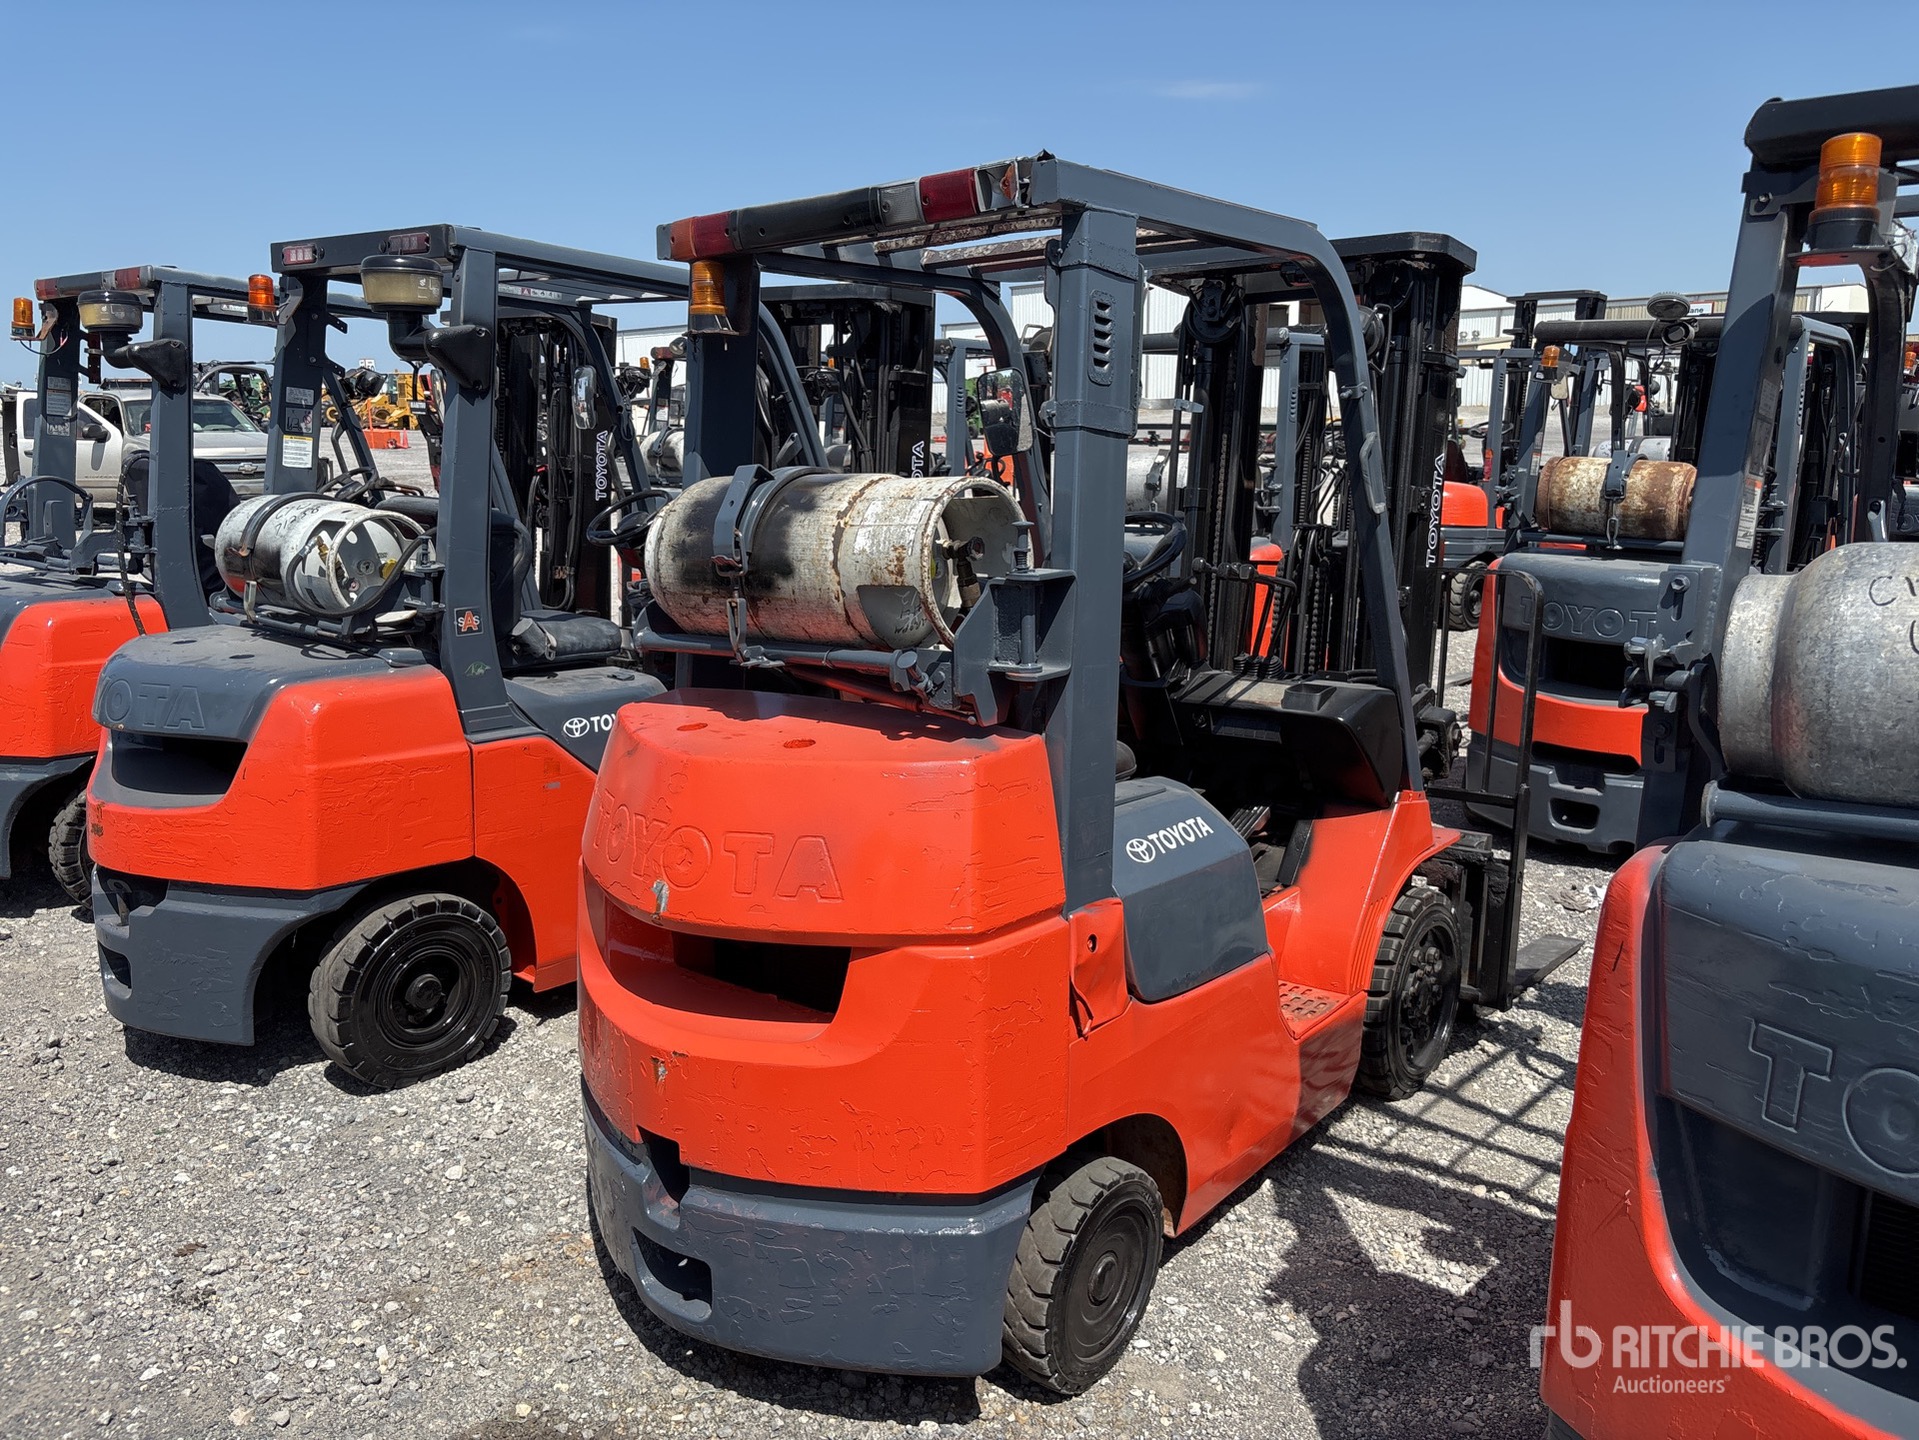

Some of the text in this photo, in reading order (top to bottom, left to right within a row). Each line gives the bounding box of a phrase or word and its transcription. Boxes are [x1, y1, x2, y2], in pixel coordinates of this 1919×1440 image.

[595, 430, 609, 501] TOYOTA
[1425, 452, 1446, 568] TOYOTA
[593, 787, 845, 905] TOYOTA
[1147, 816, 1214, 854] TOYOTA
